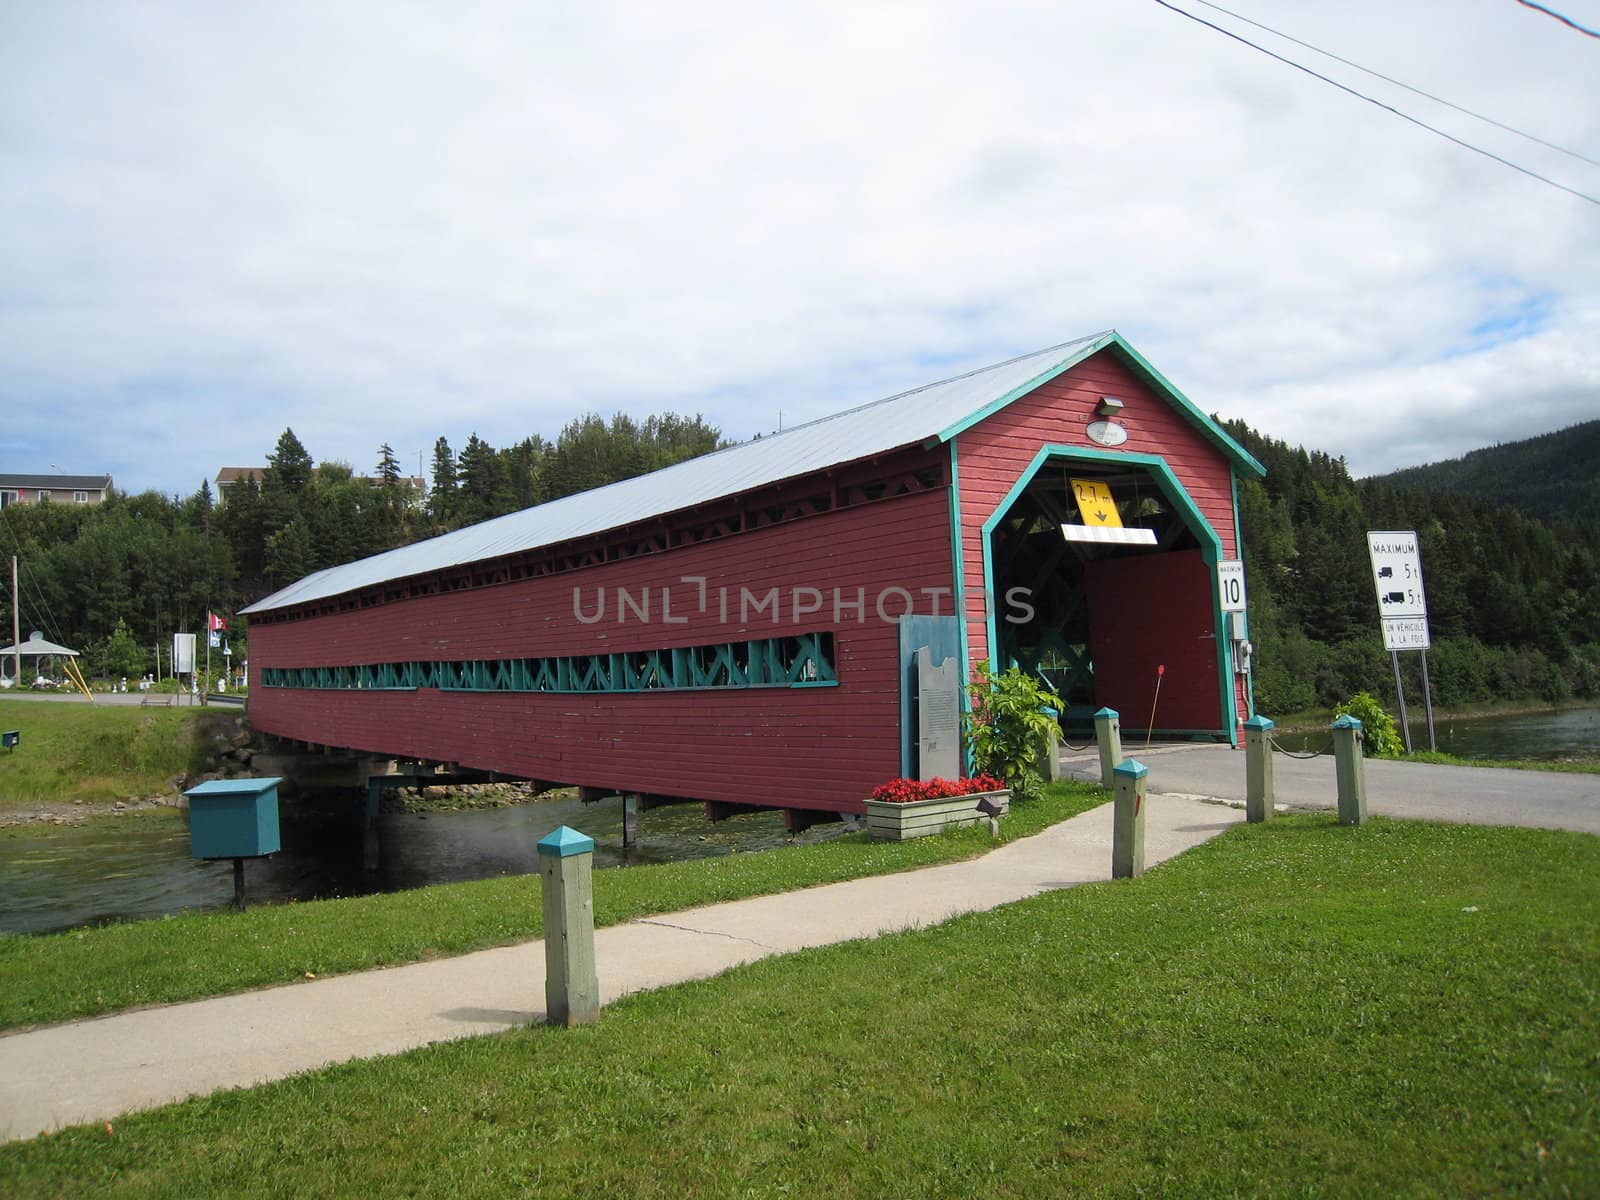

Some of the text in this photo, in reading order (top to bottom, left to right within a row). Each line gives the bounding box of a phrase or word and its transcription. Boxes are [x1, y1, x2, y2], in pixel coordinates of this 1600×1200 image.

[1373, 544, 1415, 553] MAXIMUM
[1404, 564, 1411, 579] 5
[1224, 578, 1240, 604] 10
[1407, 589, 1415, 605] 5
[1386, 623, 1394, 632] UN
[1399, 634, 1407, 643] LA
[1411, 634, 1424, 643] FOIS
